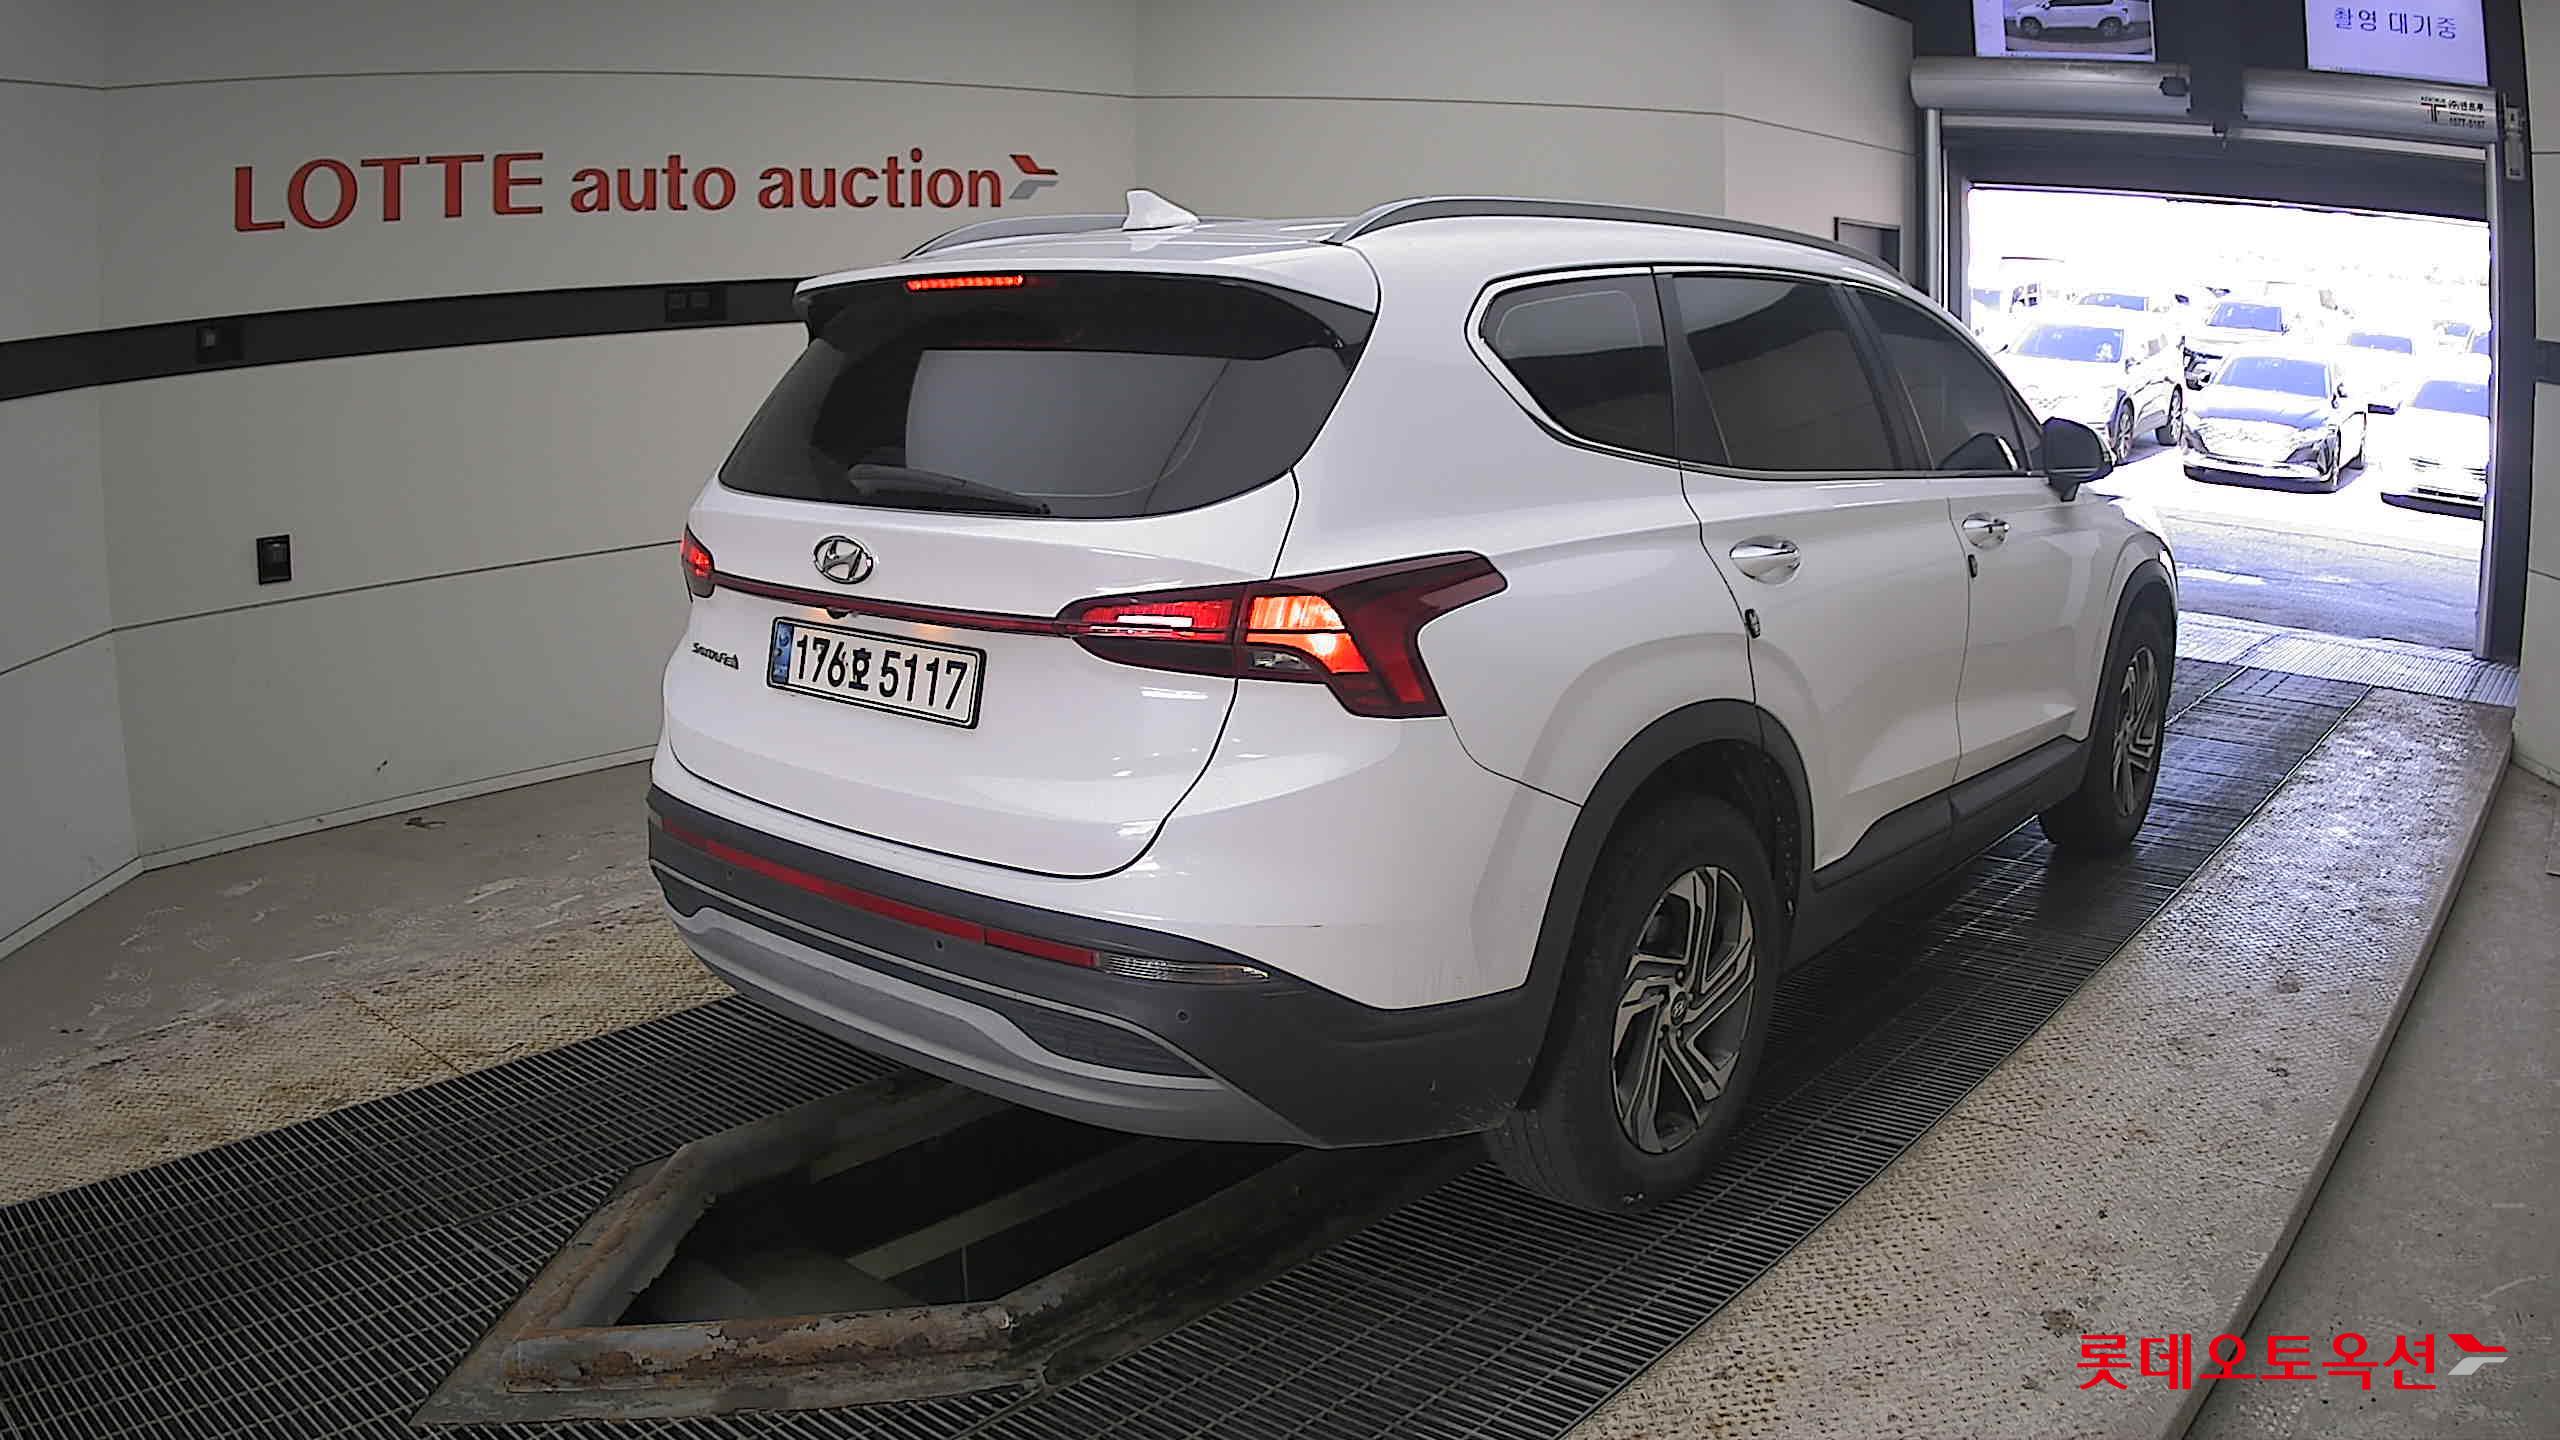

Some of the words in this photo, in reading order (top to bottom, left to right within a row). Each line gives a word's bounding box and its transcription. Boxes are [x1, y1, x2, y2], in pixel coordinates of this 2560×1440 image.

[2388, 12, 2457, 39] 대기중
[235, 151, 543, 232] LOTTE
[569, 154, 737, 213] auto
[757, 147, 1003, 210] auction
[797, 634, 872, 692] 176호
[879, 649, 968, 710] 5117
